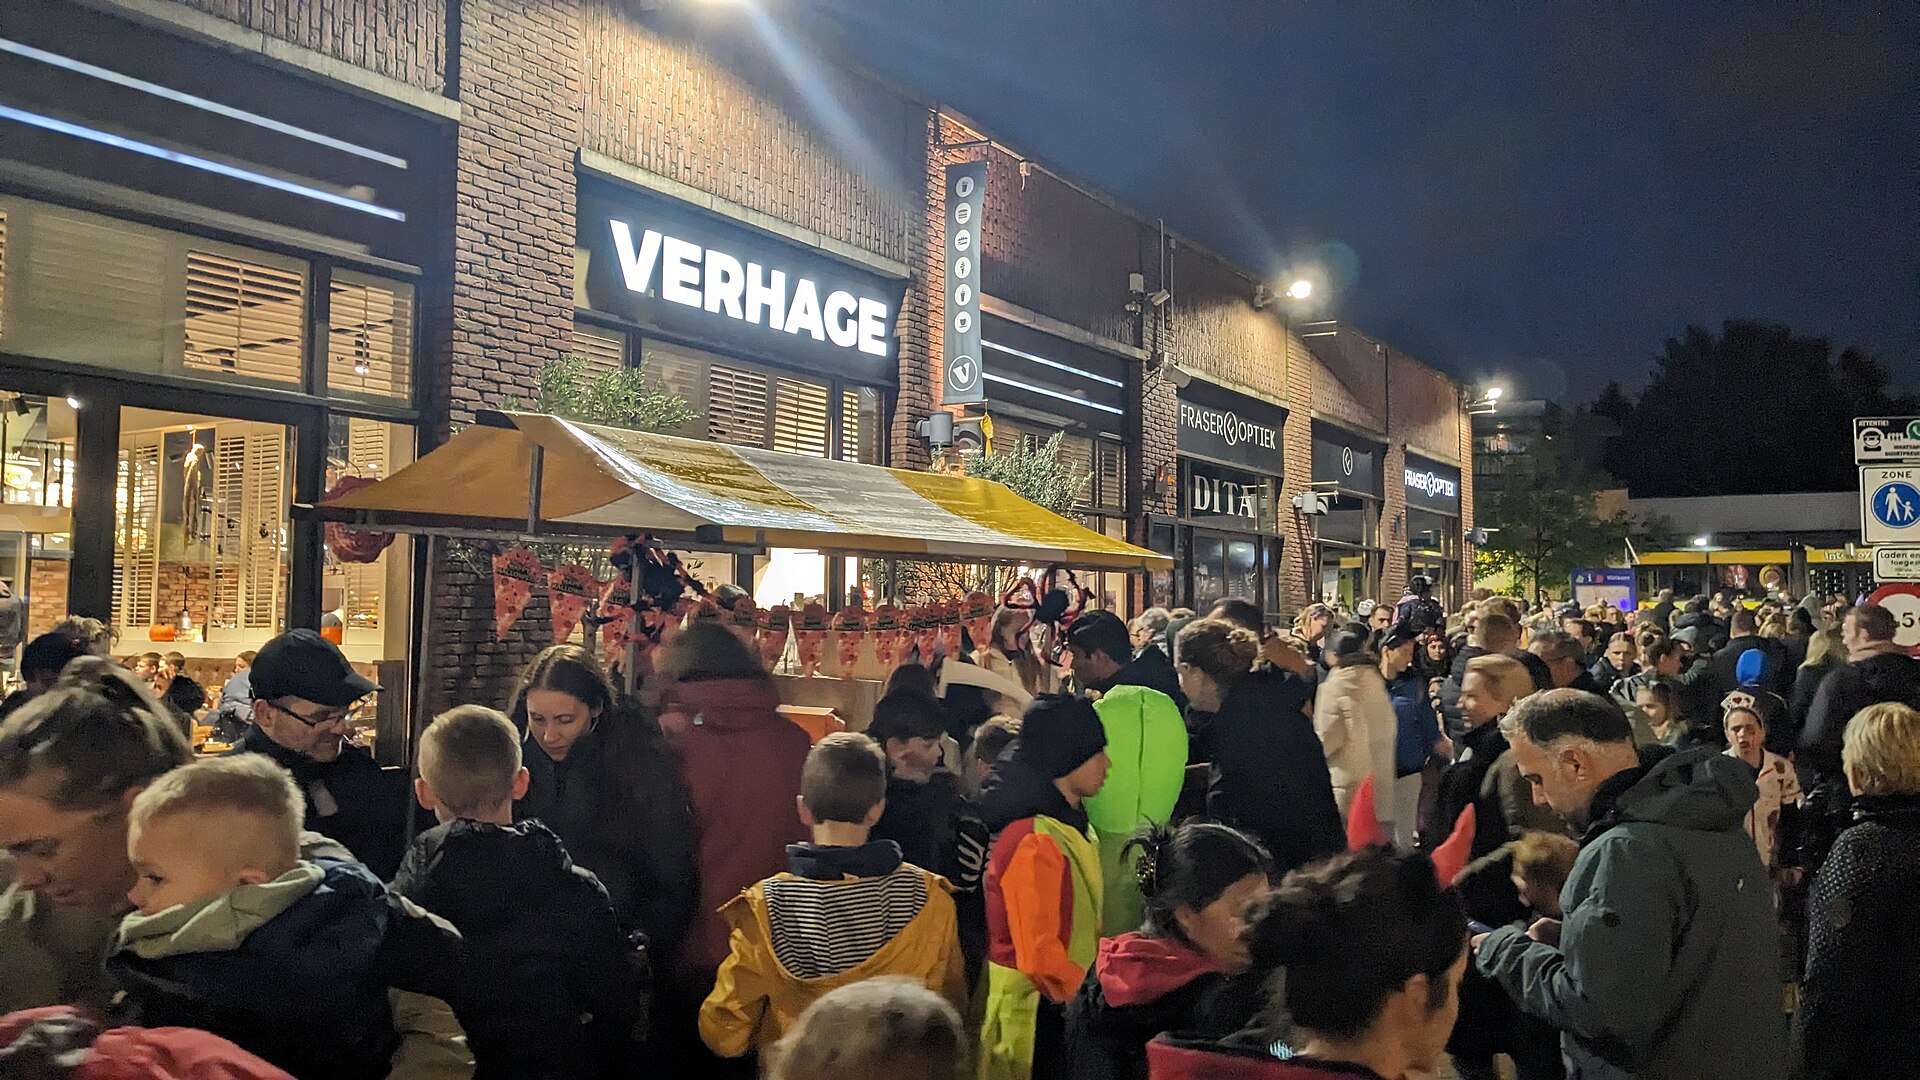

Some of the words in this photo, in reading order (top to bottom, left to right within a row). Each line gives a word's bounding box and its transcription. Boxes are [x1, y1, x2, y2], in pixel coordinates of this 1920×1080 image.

[608, 217, 888, 358] VERHAGE
[1180, 404, 1223, 437] FRASER
[1238, 422, 1276, 450] OPTIEK
[1193, 474, 1256, 518] DITA
[1404, 469, 1427, 490] FRASER
[1881, 470, 1913, 479] ZONE
